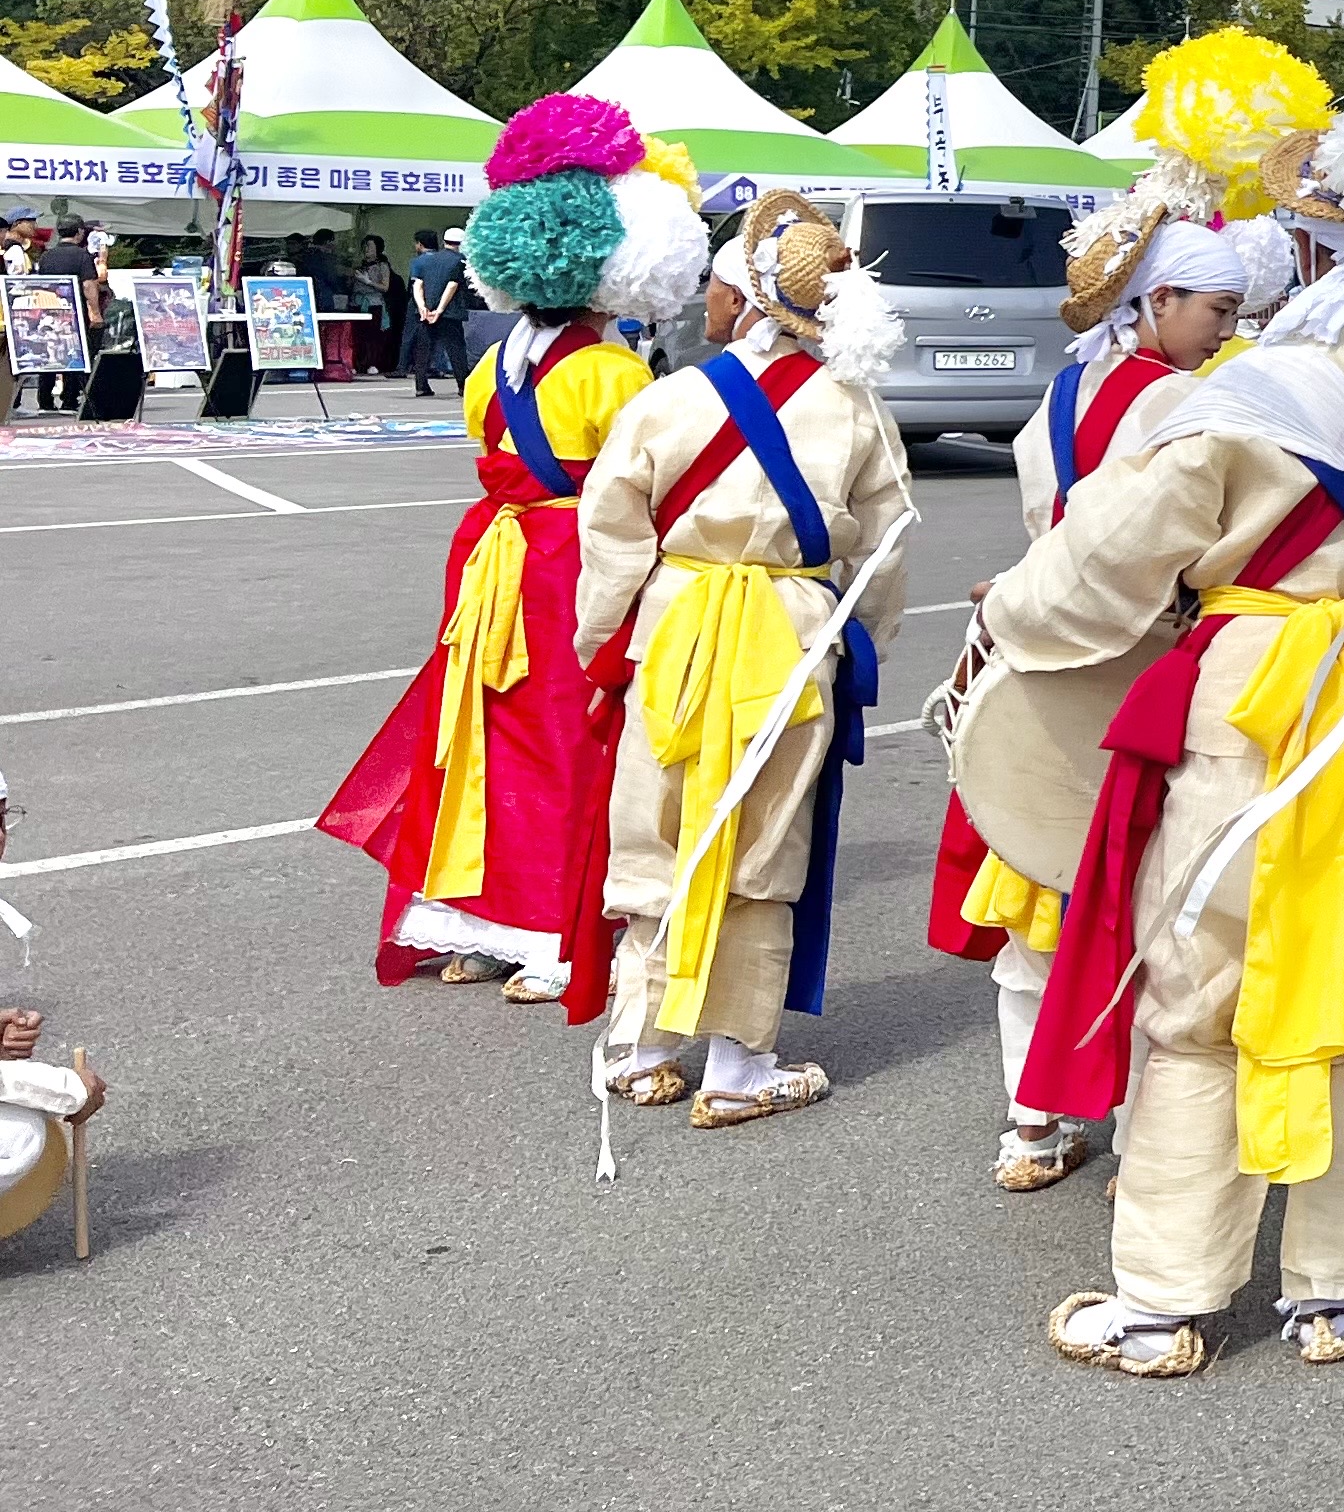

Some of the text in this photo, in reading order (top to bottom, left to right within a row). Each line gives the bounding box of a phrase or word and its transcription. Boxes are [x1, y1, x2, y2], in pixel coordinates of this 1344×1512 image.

[6, 157, 108, 182] 으라차차
[277, 166, 321, 189] 좋은
[330, 168, 372, 191] 마을
[381, 170, 464, 193] 동호동!!!
[735, 185, 754, 201] 88
[974, 354, 1008, 366] 6262
